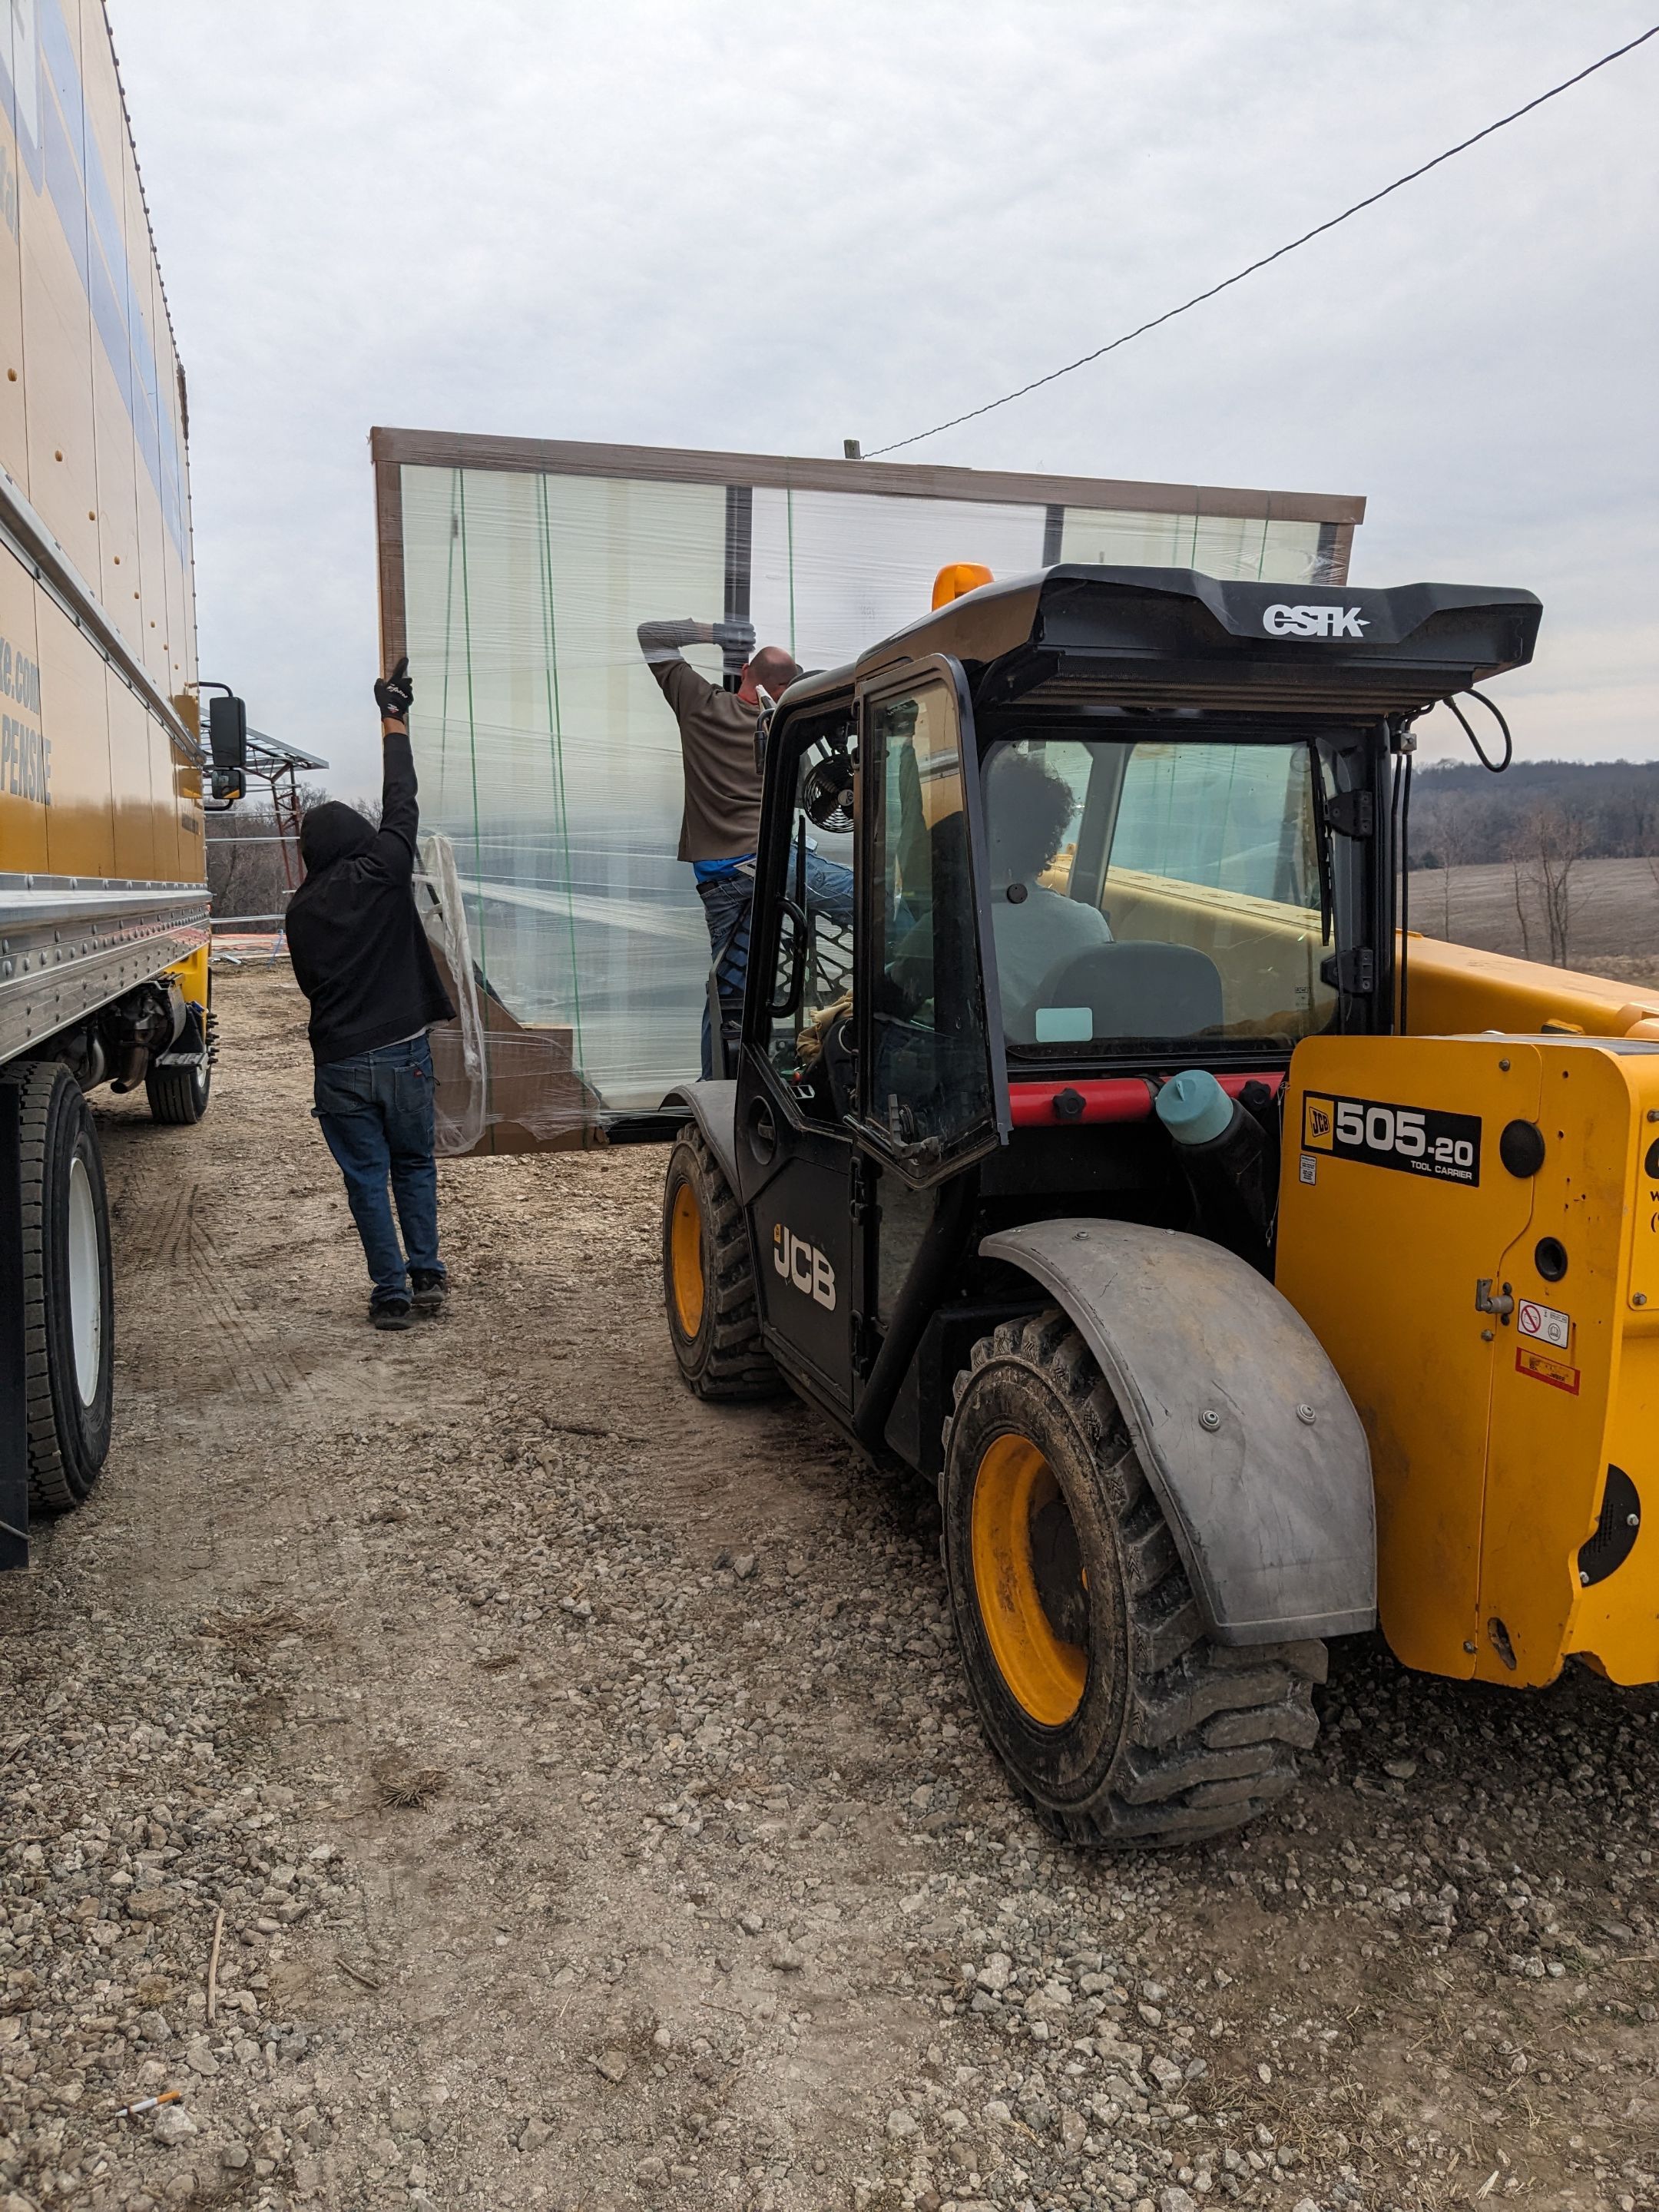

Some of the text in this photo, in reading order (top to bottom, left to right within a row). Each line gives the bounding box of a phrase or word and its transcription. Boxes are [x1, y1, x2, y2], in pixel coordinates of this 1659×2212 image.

[1263, 604, 1364, 637] CSTK
[1, 714, 51, 806] PENSKE
[1310, 1110, 1330, 1135] JCB
[1410, 1160, 1472, 1181] TOOL CARRIER
[773, 1223, 836, 1311] JCB
